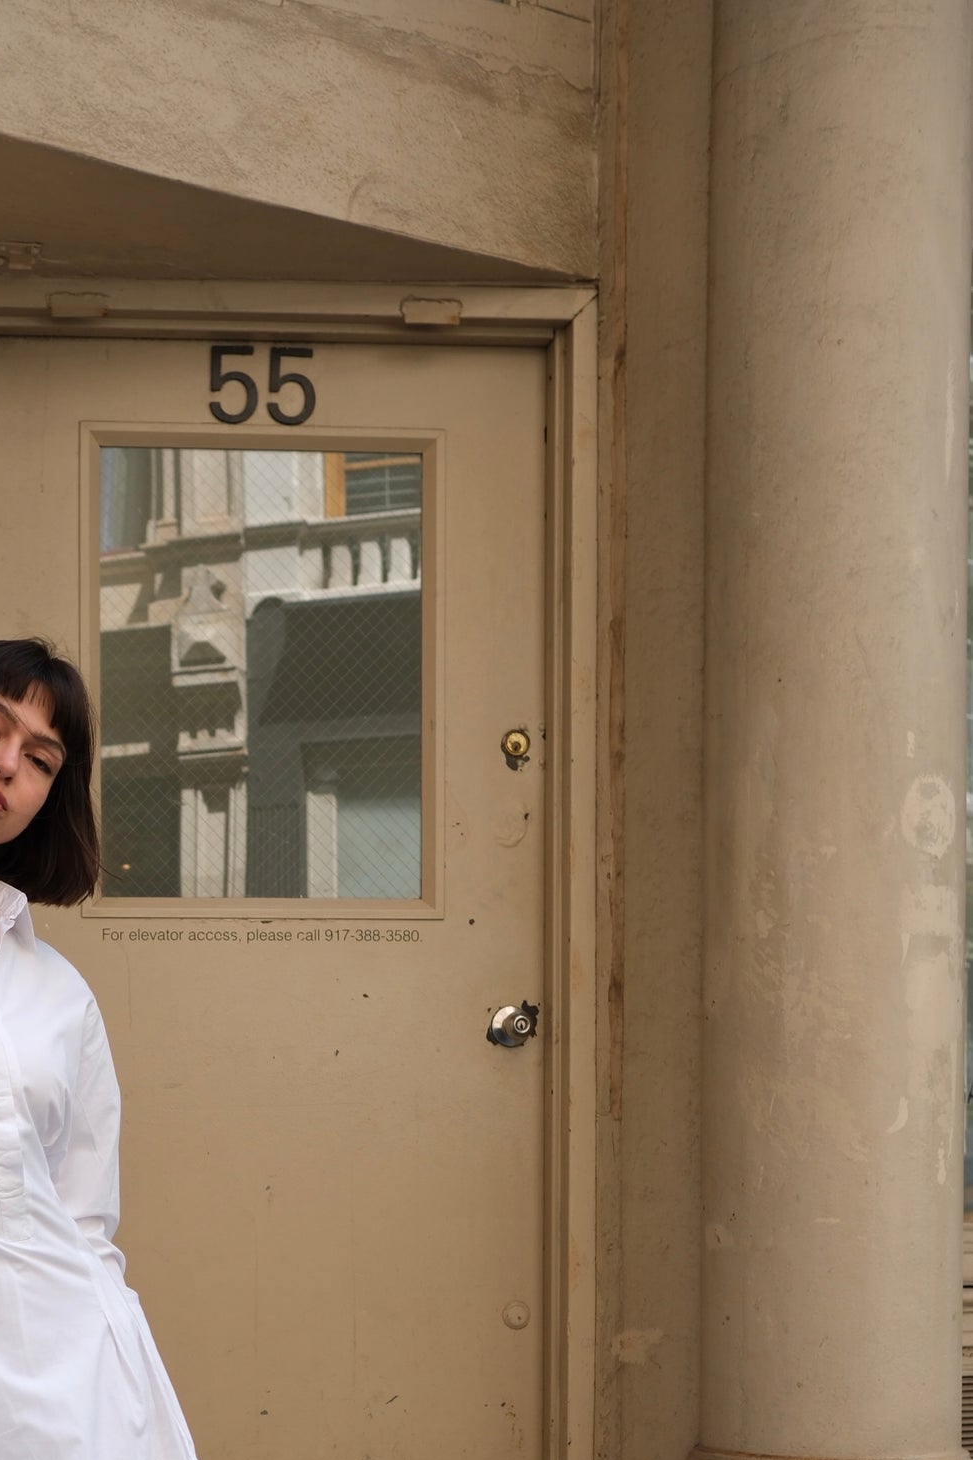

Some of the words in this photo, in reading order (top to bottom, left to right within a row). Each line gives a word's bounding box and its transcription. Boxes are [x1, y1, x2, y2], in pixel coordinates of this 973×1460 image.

[209, 345, 316, 426] 55
[101, 928, 124, 941] For
[128, 928, 184, 942] elevator
[246, 929, 293, 944] please
[296, 929, 320, 942] call
[324, 928, 423, 943] 917-388-3580.
